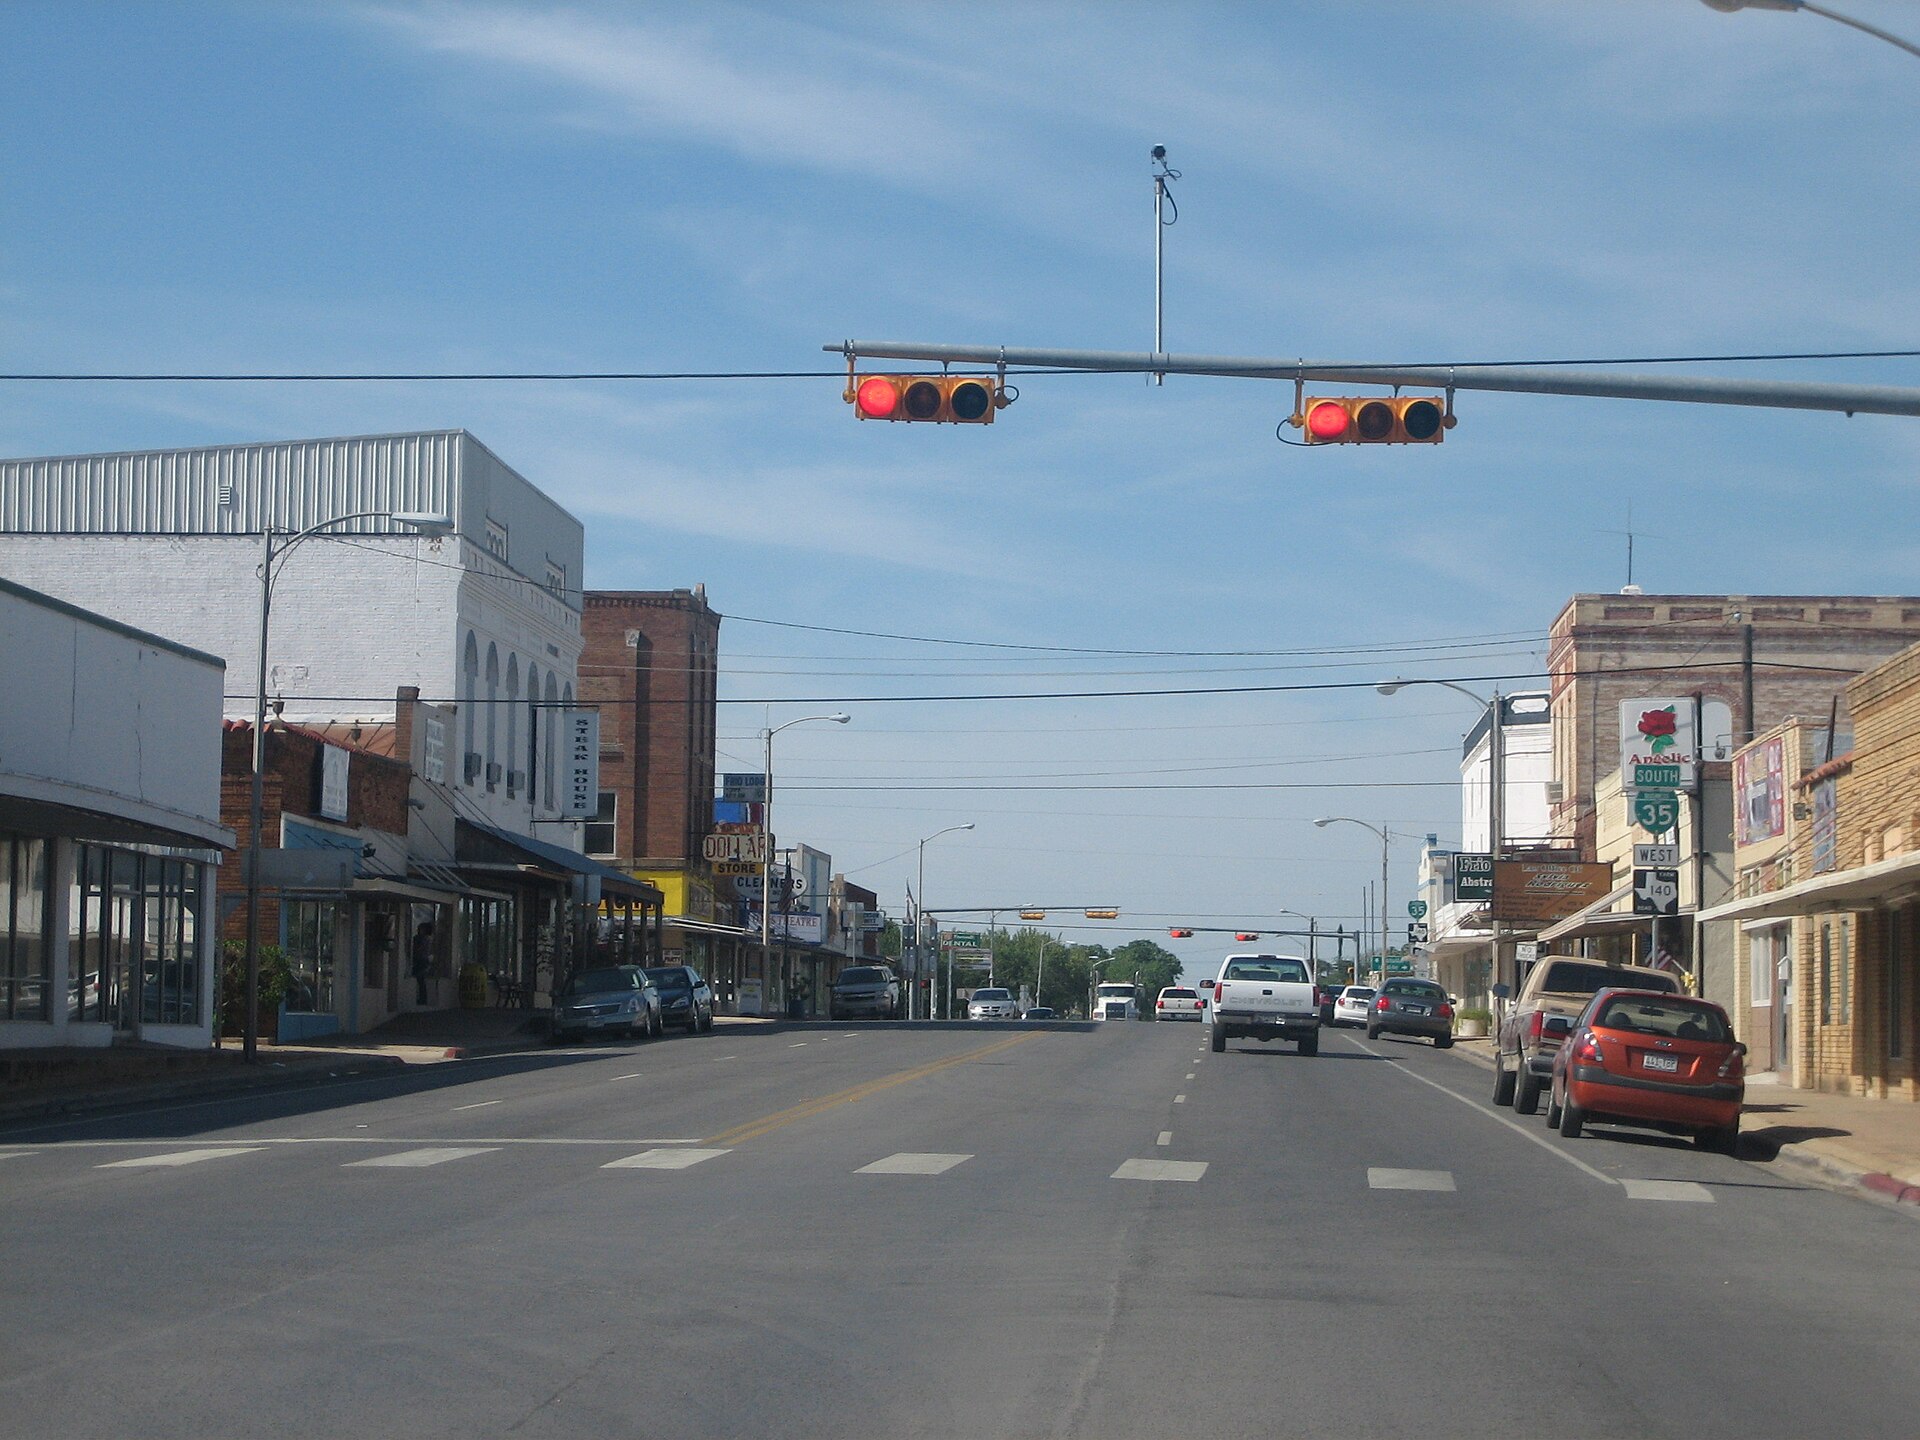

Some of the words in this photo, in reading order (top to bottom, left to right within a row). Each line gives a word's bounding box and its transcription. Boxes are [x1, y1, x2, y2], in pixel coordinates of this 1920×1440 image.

[574, 719, 589, 760] STEAK
[1629, 753, 1691, 765] Angelic
[1636, 769, 1680, 783] SOUTH
[573, 768, 588, 809] HOUSE
[1642, 804, 1673, 826] 35
[1640, 849, 1673, 862] WEST
[718, 863, 756, 873] STORE
[1460, 857, 1491, 872] Frio
[1651, 885, 1671, 896] 140
[1411, 905, 1425, 916] 35
[776, 916, 818, 927] TEATRE
[1230, 996, 1305, 1007] CHEVROLET
